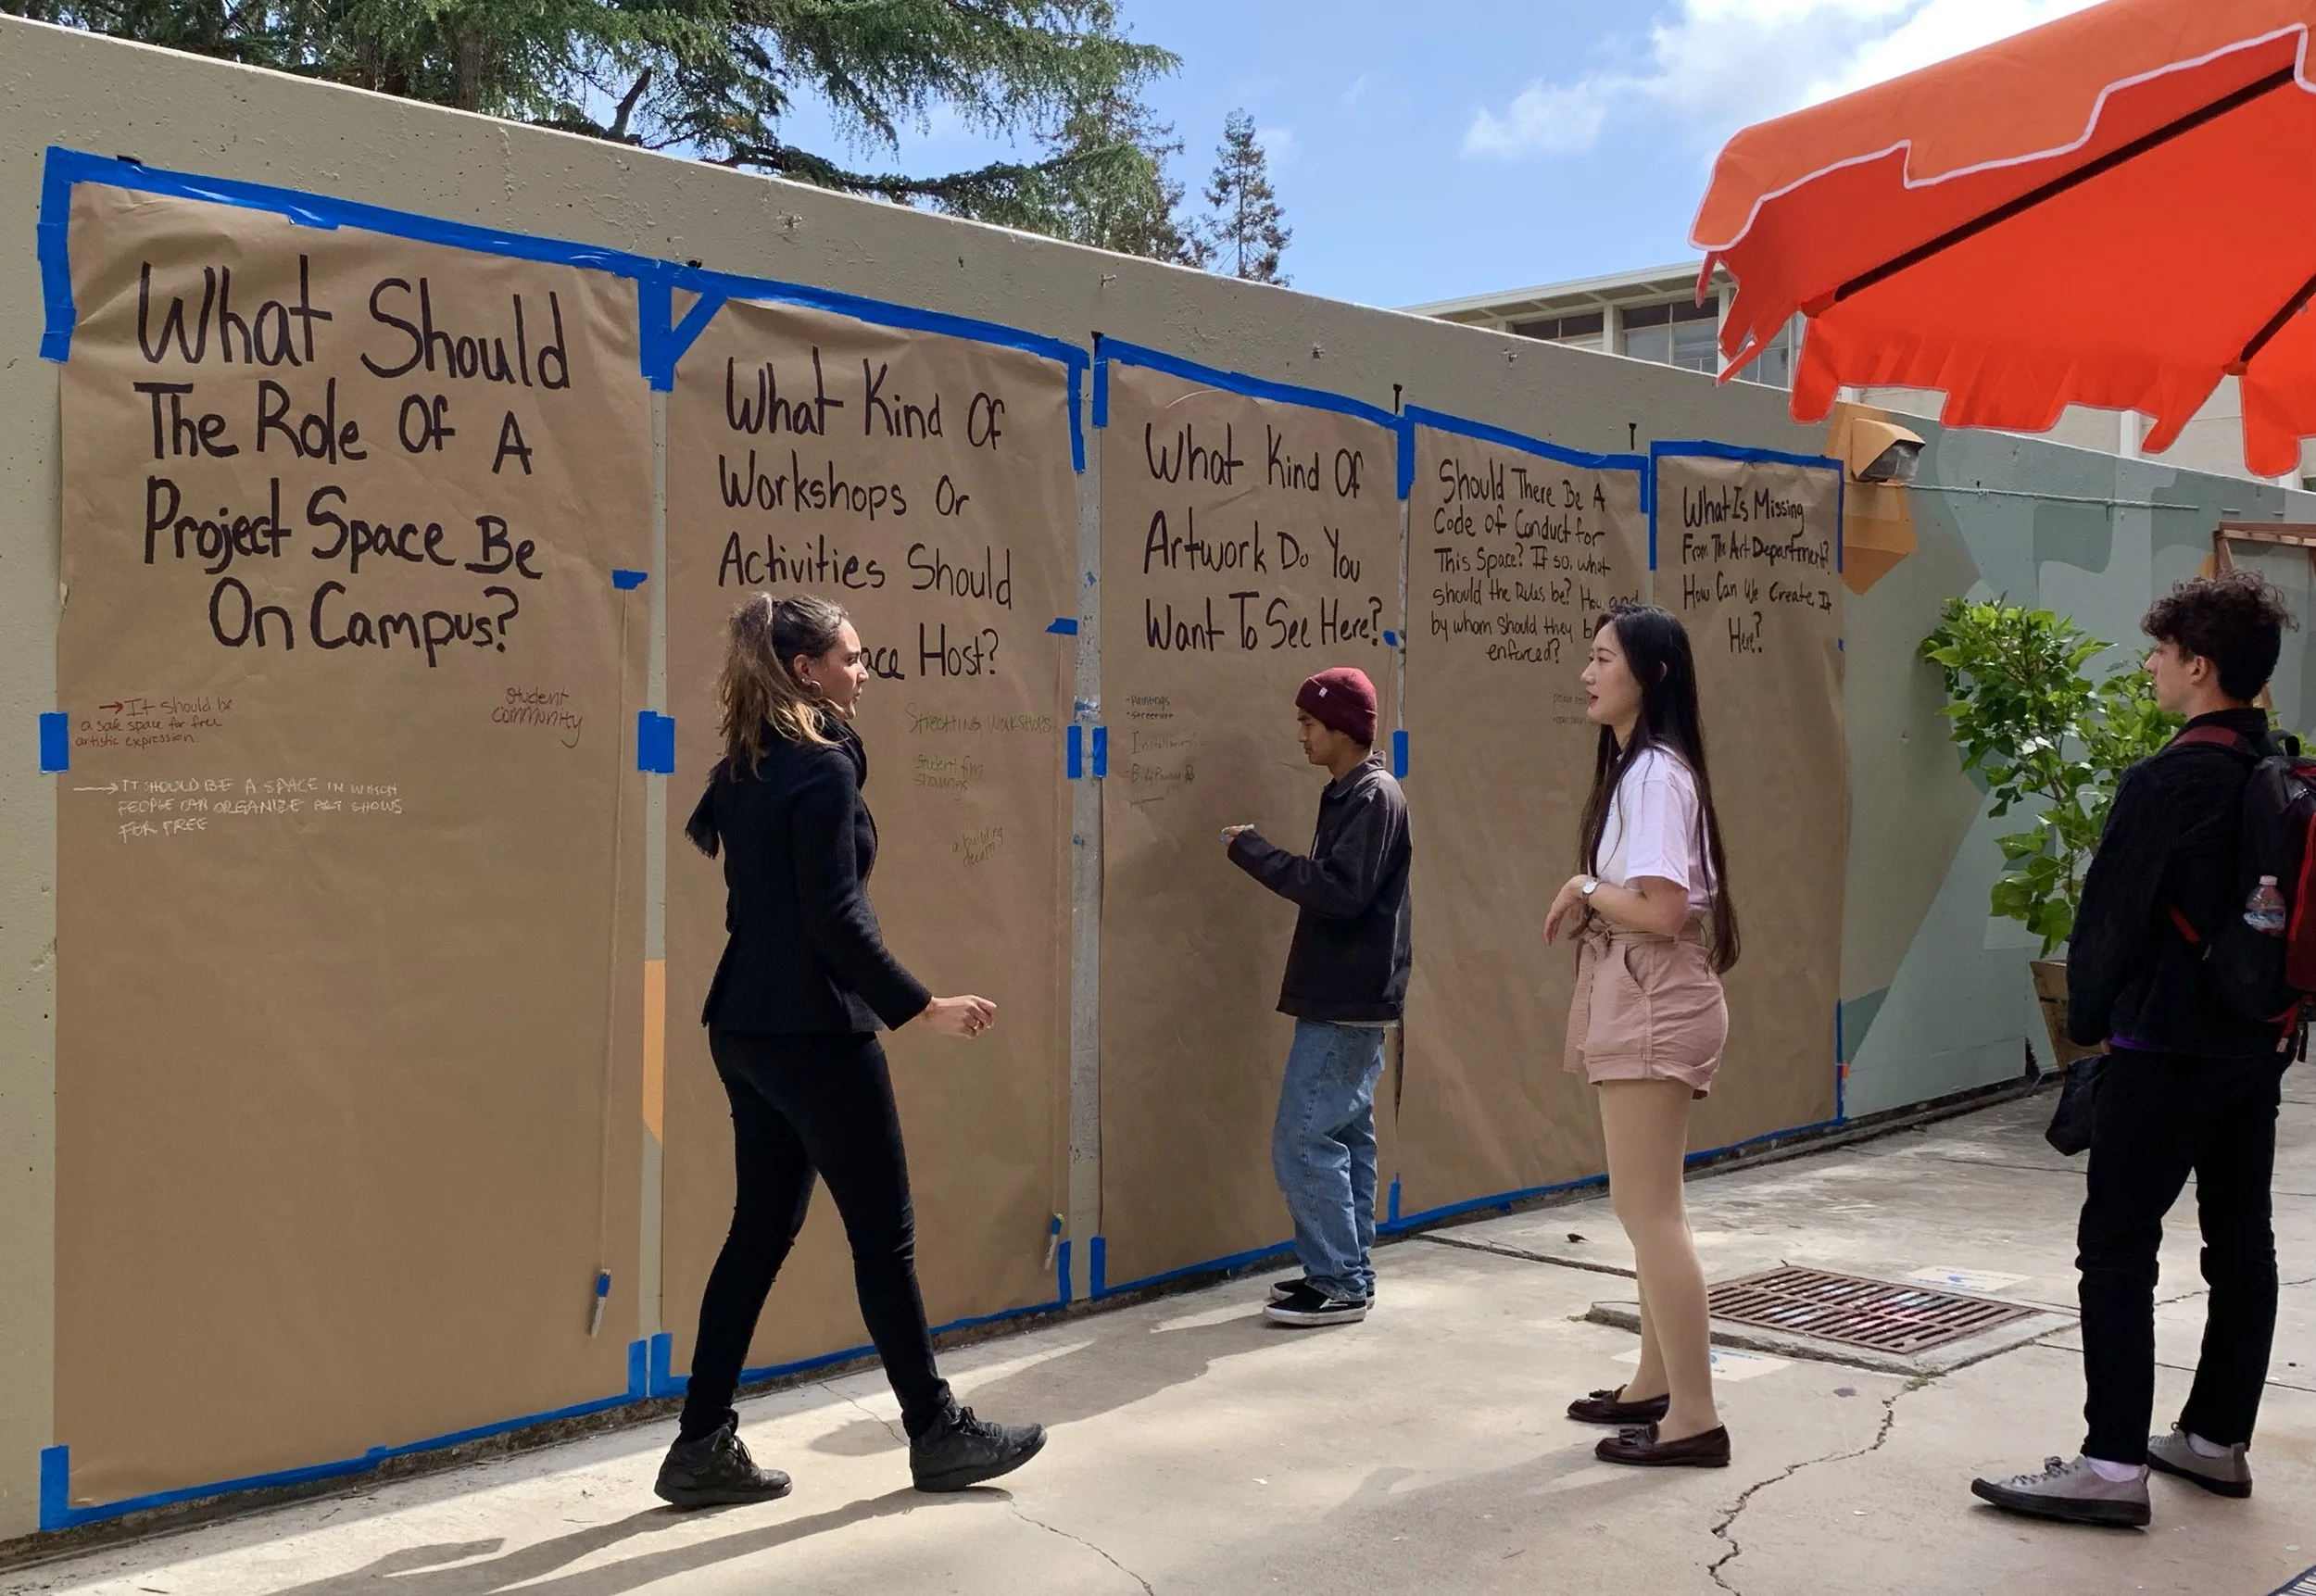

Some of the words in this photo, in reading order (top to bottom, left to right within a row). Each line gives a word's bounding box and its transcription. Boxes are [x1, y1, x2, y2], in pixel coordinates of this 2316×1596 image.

[138, 255, 333, 365] What
[360, 277, 572, 389] Should
[726, 346, 844, 436] What
[862, 358, 943, 439] Kind
[966, 392, 1005, 450] Of
[132, 381, 240, 460] The
[257, 377, 369, 464] Role
[398, 393, 456, 454] Of
[491, 410, 534, 475] A
[1145, 422, 1244, 485] What
[1266, 424, 1319, 491] Kind
[1334, 447, 1364, 499] Of
[718, 448, 907, 521] Workshops
[936, 474, 970, 516] Or
[1439, 458, 1504, 504] Should
[1511, 468, 1556, 508] There
[1562, 479, 1584, 511] Be
[1593, 483, 1605, 512] A
[145, 475, 292, 574] Project
[307, 485, 458, 574] Space
[464, 515, 544, 580] Be
[1434, 504, 1477, 537] Code
[1515, 509, 1571, 544] Conduct
[1575, 517, 1605, 547] for
[1683, 484, 1731, 527] What
[1731, 486, 1748, 522] Is
[1755, 487, 1805, 539] Missing
[1143, 506, 1267, 574] Artwork
[1277, 531, 1309, 570] Do
[1323, 525, 1361, 583] You
[1433, 547, 1471, 573] This
[1477, 542, 1524, 578] Space?
[1530, 545, 1548, 570] If
[1553, 555, 1573, 572] so,
[1577, 554, 1611, 577] what
[1683, 533, 1707, 565] From
[1711, 534, 1726, 563] The
[1730, 530, 1750, 559] Art
[1753, 536, 1831, 575] Department?
[718, 531, 886, 590] Activities
[907, 542, 1013, 610] Should
[1433, 576, 1482, 607] should
[1489, 576, 1511, 602] the
[1515, 580, 1546, 602] Rules
[1551, 577, 1572, 606] be?
[1683, 573, 1710, 609] How
[1717, 571, 1737, 602] Can
[1744, 578, 1758, 604] We
[1769, 582, 1814, 608] Create
[1818, 590, 1832, 615] It
[209, 577, 295, 650] On
[310, 582, 519, 668] Campus?
[1145, 597, 1225, 651] Want
[1228, 591, 1260, 649] To
[1265, 597, 1312, 649] See
[1320, 596, 1382, 647] Here?
[1431, 610, 1448, 641] by
[1454, 610, 1492, 635] whom
[1543, 614, 1573, 643] they
[1583, 618, 1592, 639] b
[1729, 611, 1763, 654] Here?
[861, 647, 905, 680] ace
[919, 622, 1000, 679] Host?
[1486, 637, 1561, 664] enforced?
[81, 721, 94, 732] a
[97, 719, 124, 733] safe
[128, 720, 164, 734] space
[169, 718, 185, 731] for
[191, 715, 223, 729] free
[124, 698, 156, 717] It
[217, 696, 233, 711] be
[76, 735, 120, 748] artistic
[125, 732, 195, 749] expression
[121, 779, 139, 792] IT
[144, 777, 199, 793] SHOULD
[205, 778, 233, 791] BE
[245, 778, 257, 795] A
[263, 777, 319, 796] SPACE
[327, 782, 344, 793] IN
[351, 783, 397, 797] WHICH
[180, 798, 208, 811] CAN
[213, 798, 304, 815] ORGANIZE
[314, 798, 343, 811] ART
[351, 798, 403, 815] SHOWS
[118, 821, 157, 844] FOR
[162, 817, 208, 836] FREE
